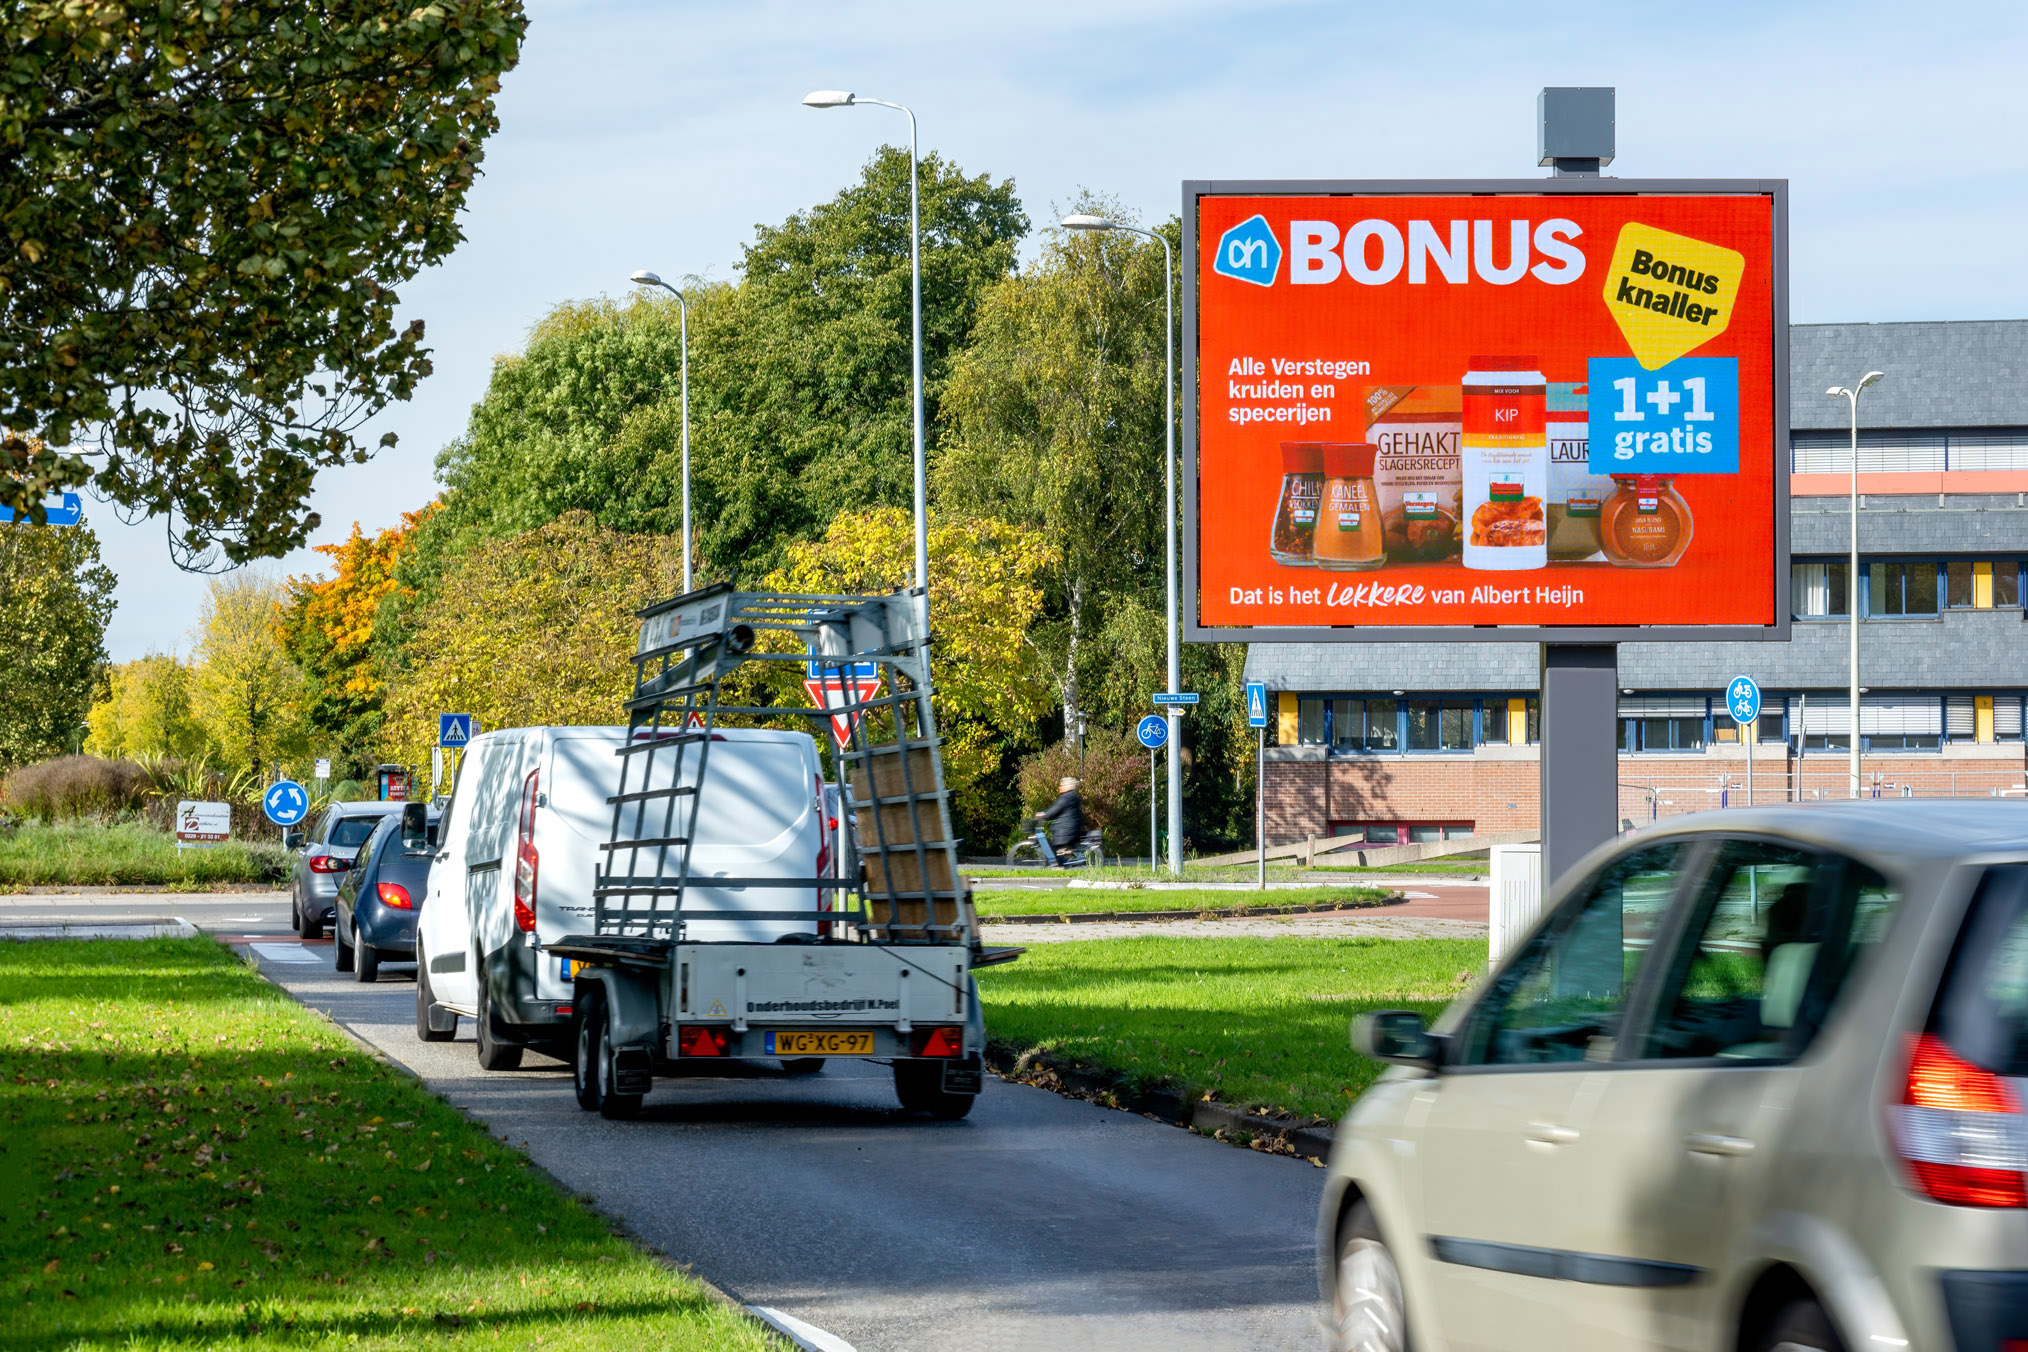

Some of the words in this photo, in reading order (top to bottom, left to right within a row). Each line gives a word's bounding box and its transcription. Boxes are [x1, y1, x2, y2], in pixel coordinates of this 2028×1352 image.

[1290, 218, 1587, 286] BONUS
[1630, 249, 1720, 295] Bonus
[1616, 276, 1718, 326] knaller
[1228, 357, 1266, 376] Alle
[1271, 358, 1371, 380] Verstegen
[1229, 380, 1304, 399] kruiden
[1310, 384, 1335, 399] en
[1613, 377, 1714, 421] 1+1
[1228, 403, 1331, 426] specerijen
[1495, 408, 1519, 422] KIP
[1378, 432, 1460, 455] GEHAKT
[1614, 424, 1713, 460] gratis
[1379, 458, 1460, 471] SLAGERSRECEPT
[1330, 484, 1368, 499] KANEEL
[1329, 502, 1370, 511] GEMALEN
[1230, 587, 1263, 604] Dat
[1268, 586, 1283, 604] is
[1290, 586, 1321, 604] het
[1431, 589, 1465, 604] van
[1471, 585, 1530, 604] Albert
[1536, 585, 1583, 608] Heijn
[780, 1034, 869, 1051] WG-XG-97
